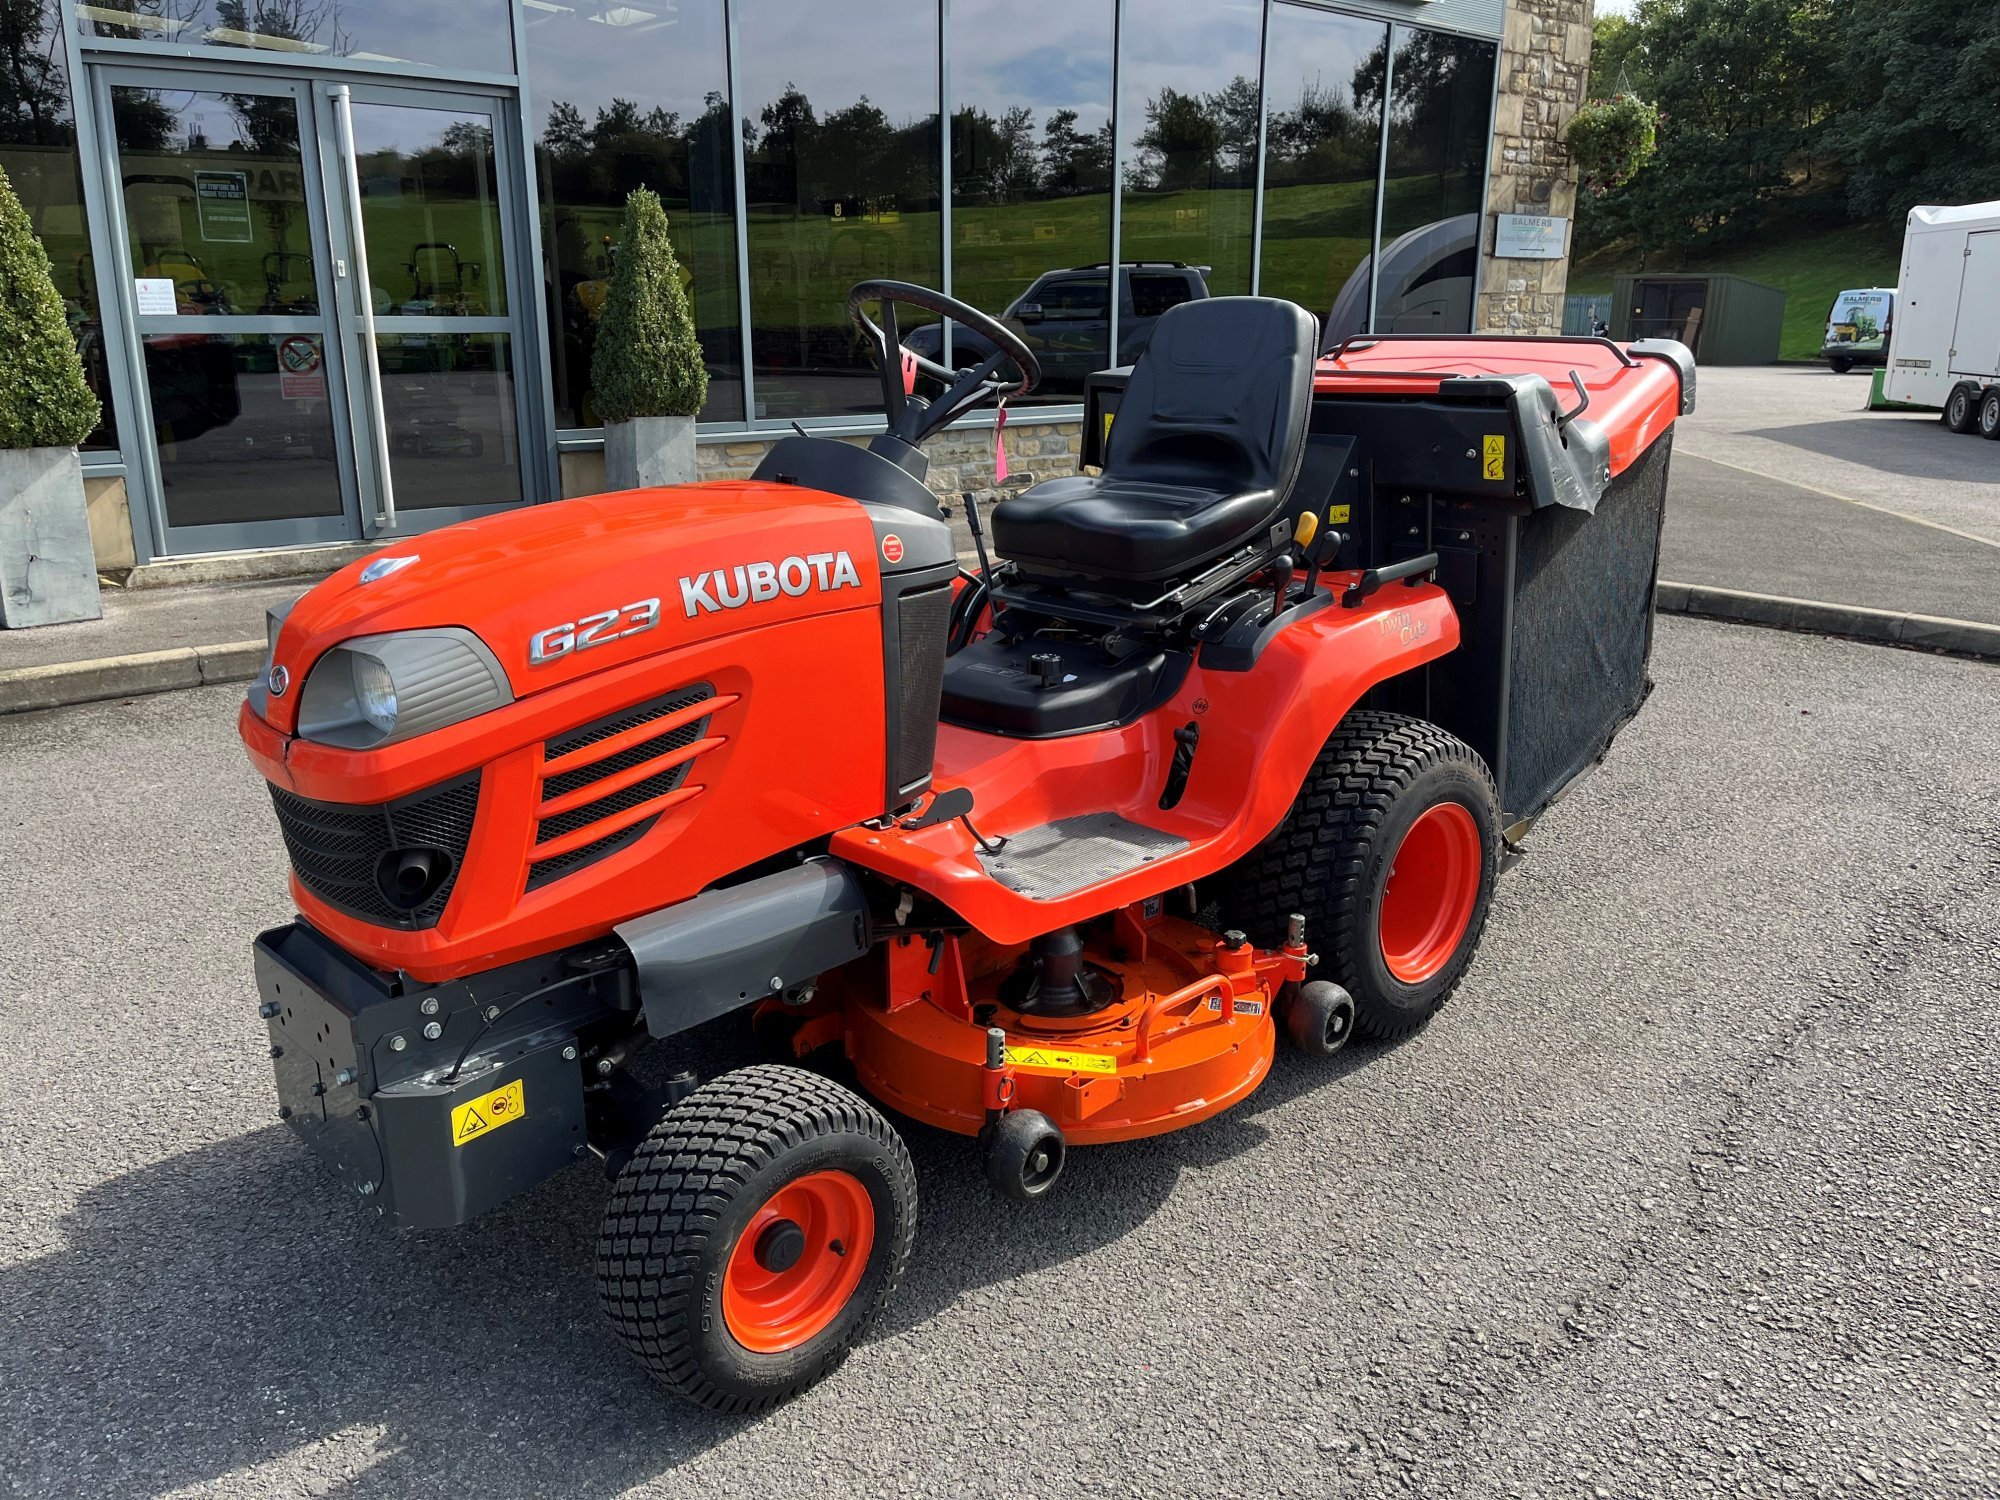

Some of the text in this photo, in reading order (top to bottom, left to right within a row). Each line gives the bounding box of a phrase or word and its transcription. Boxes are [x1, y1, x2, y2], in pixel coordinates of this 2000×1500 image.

[1512, 218, 1552, 227] BALMERS
[679, 551, 862, 617] KUBOTA
[530, 598, 660, 665] G23
[1377, 612, 1411, 635] Twin
[1400, 620, 1428, 646] Cut
[702, 1271, 718, 1332] OTR
